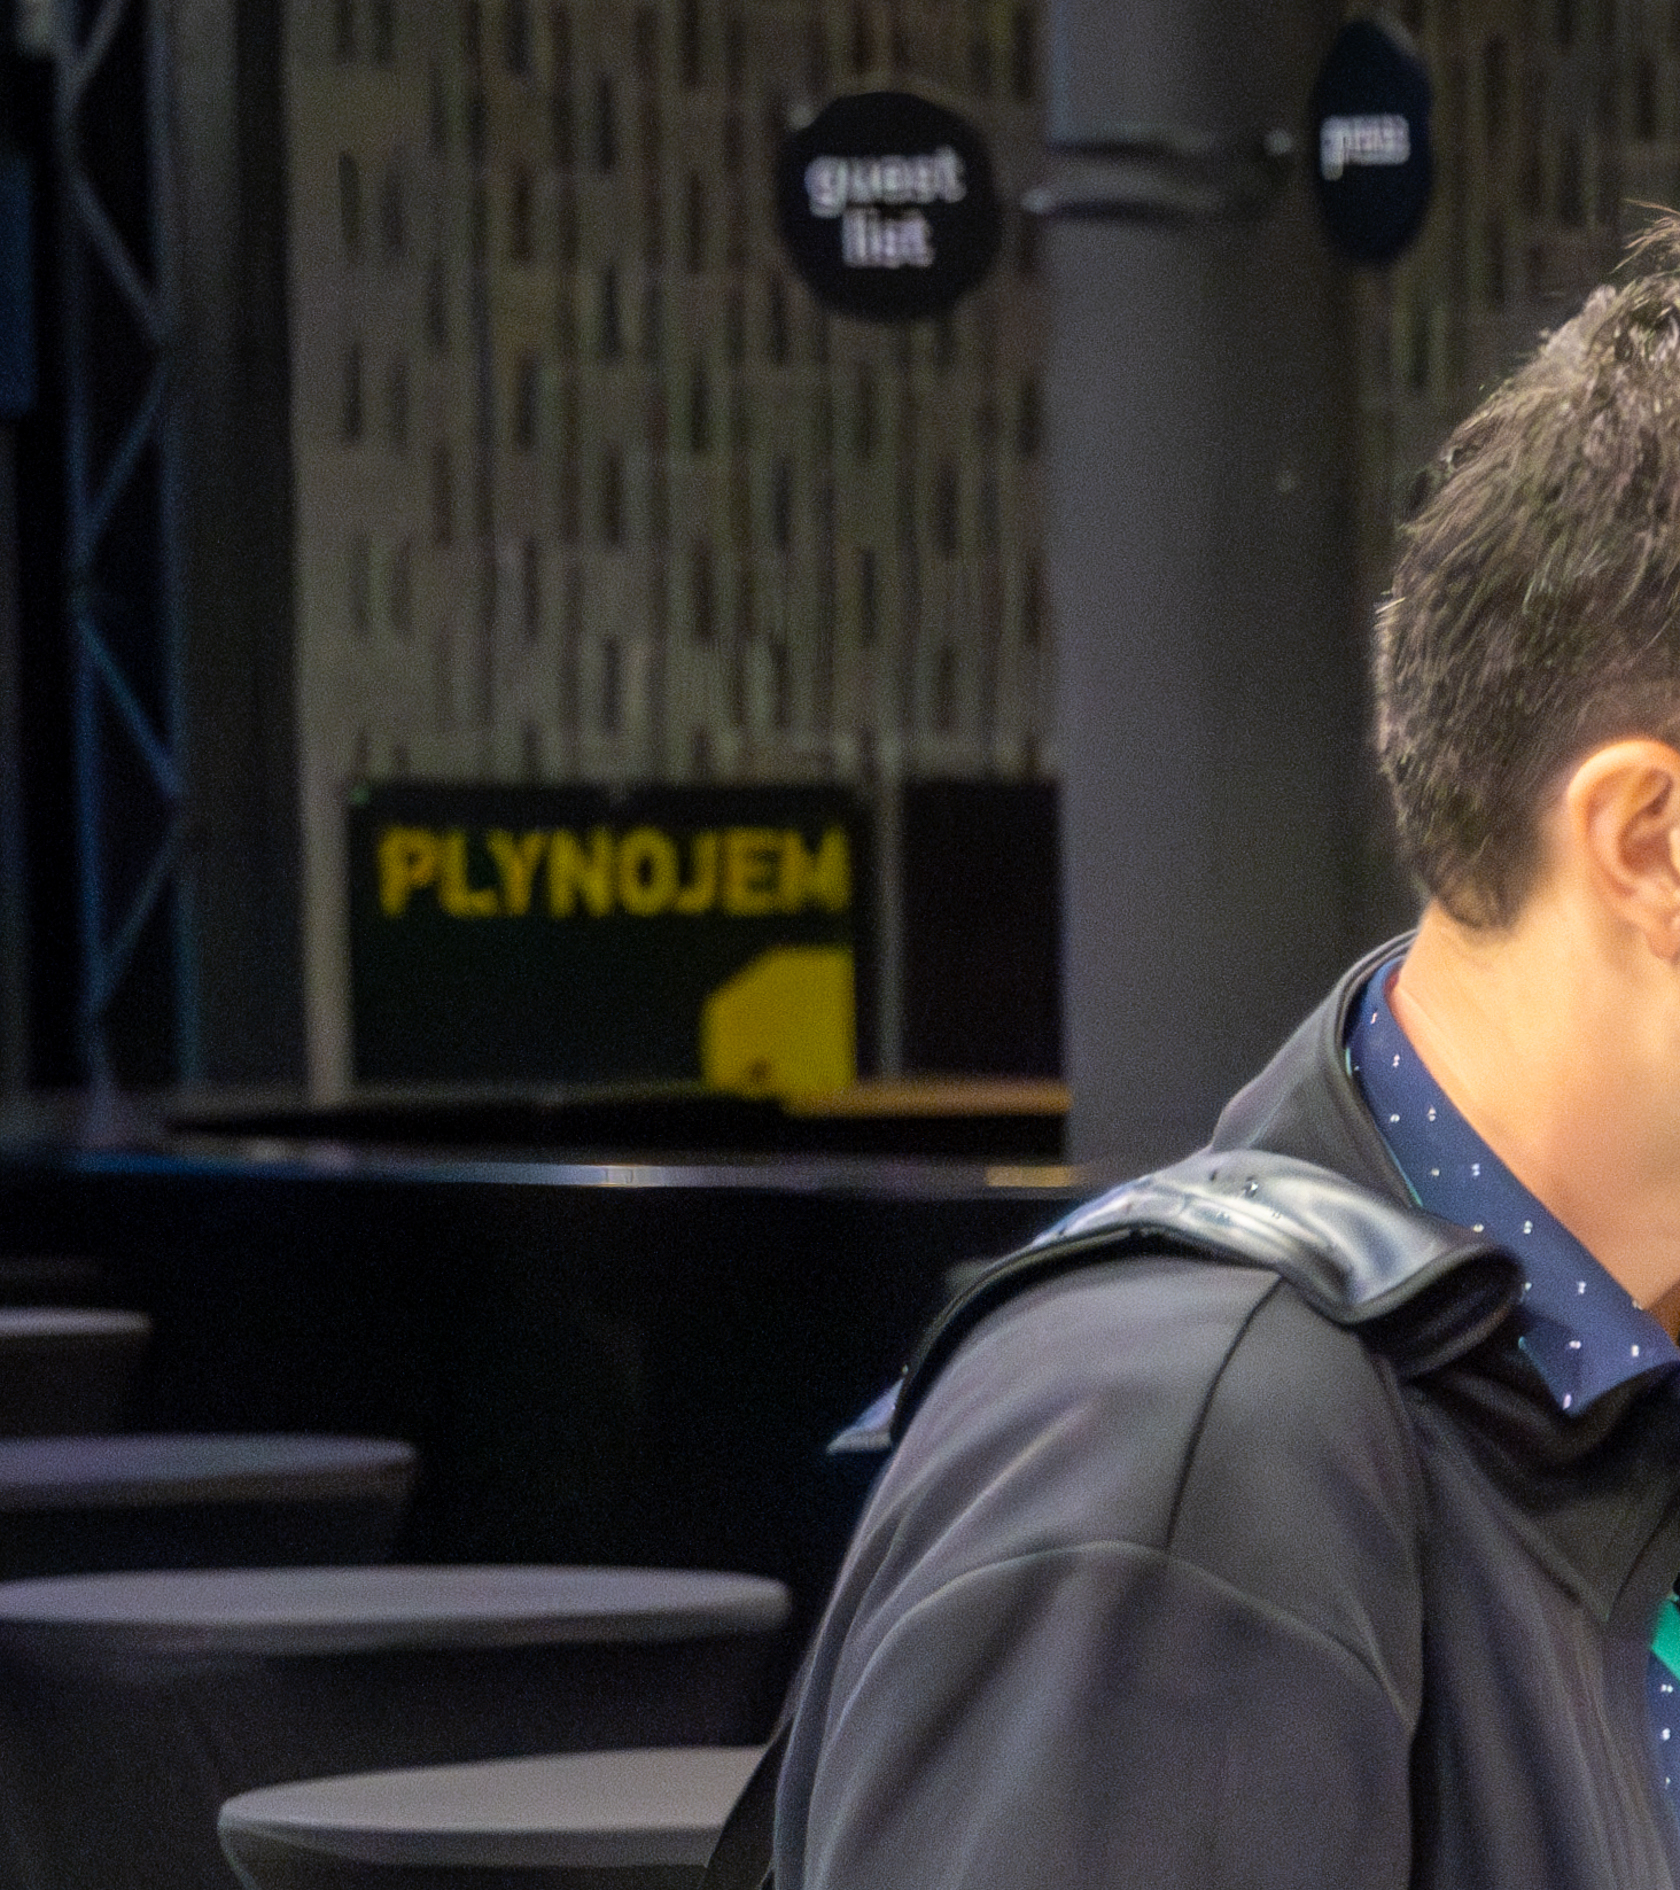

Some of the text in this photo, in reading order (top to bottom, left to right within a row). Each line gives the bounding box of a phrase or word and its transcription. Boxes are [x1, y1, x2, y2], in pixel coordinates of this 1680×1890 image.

[804, 147, 966, 217] guest
[842, 208, 932, 267] list
[379, 825, 851, 918] PLYNOJEM
